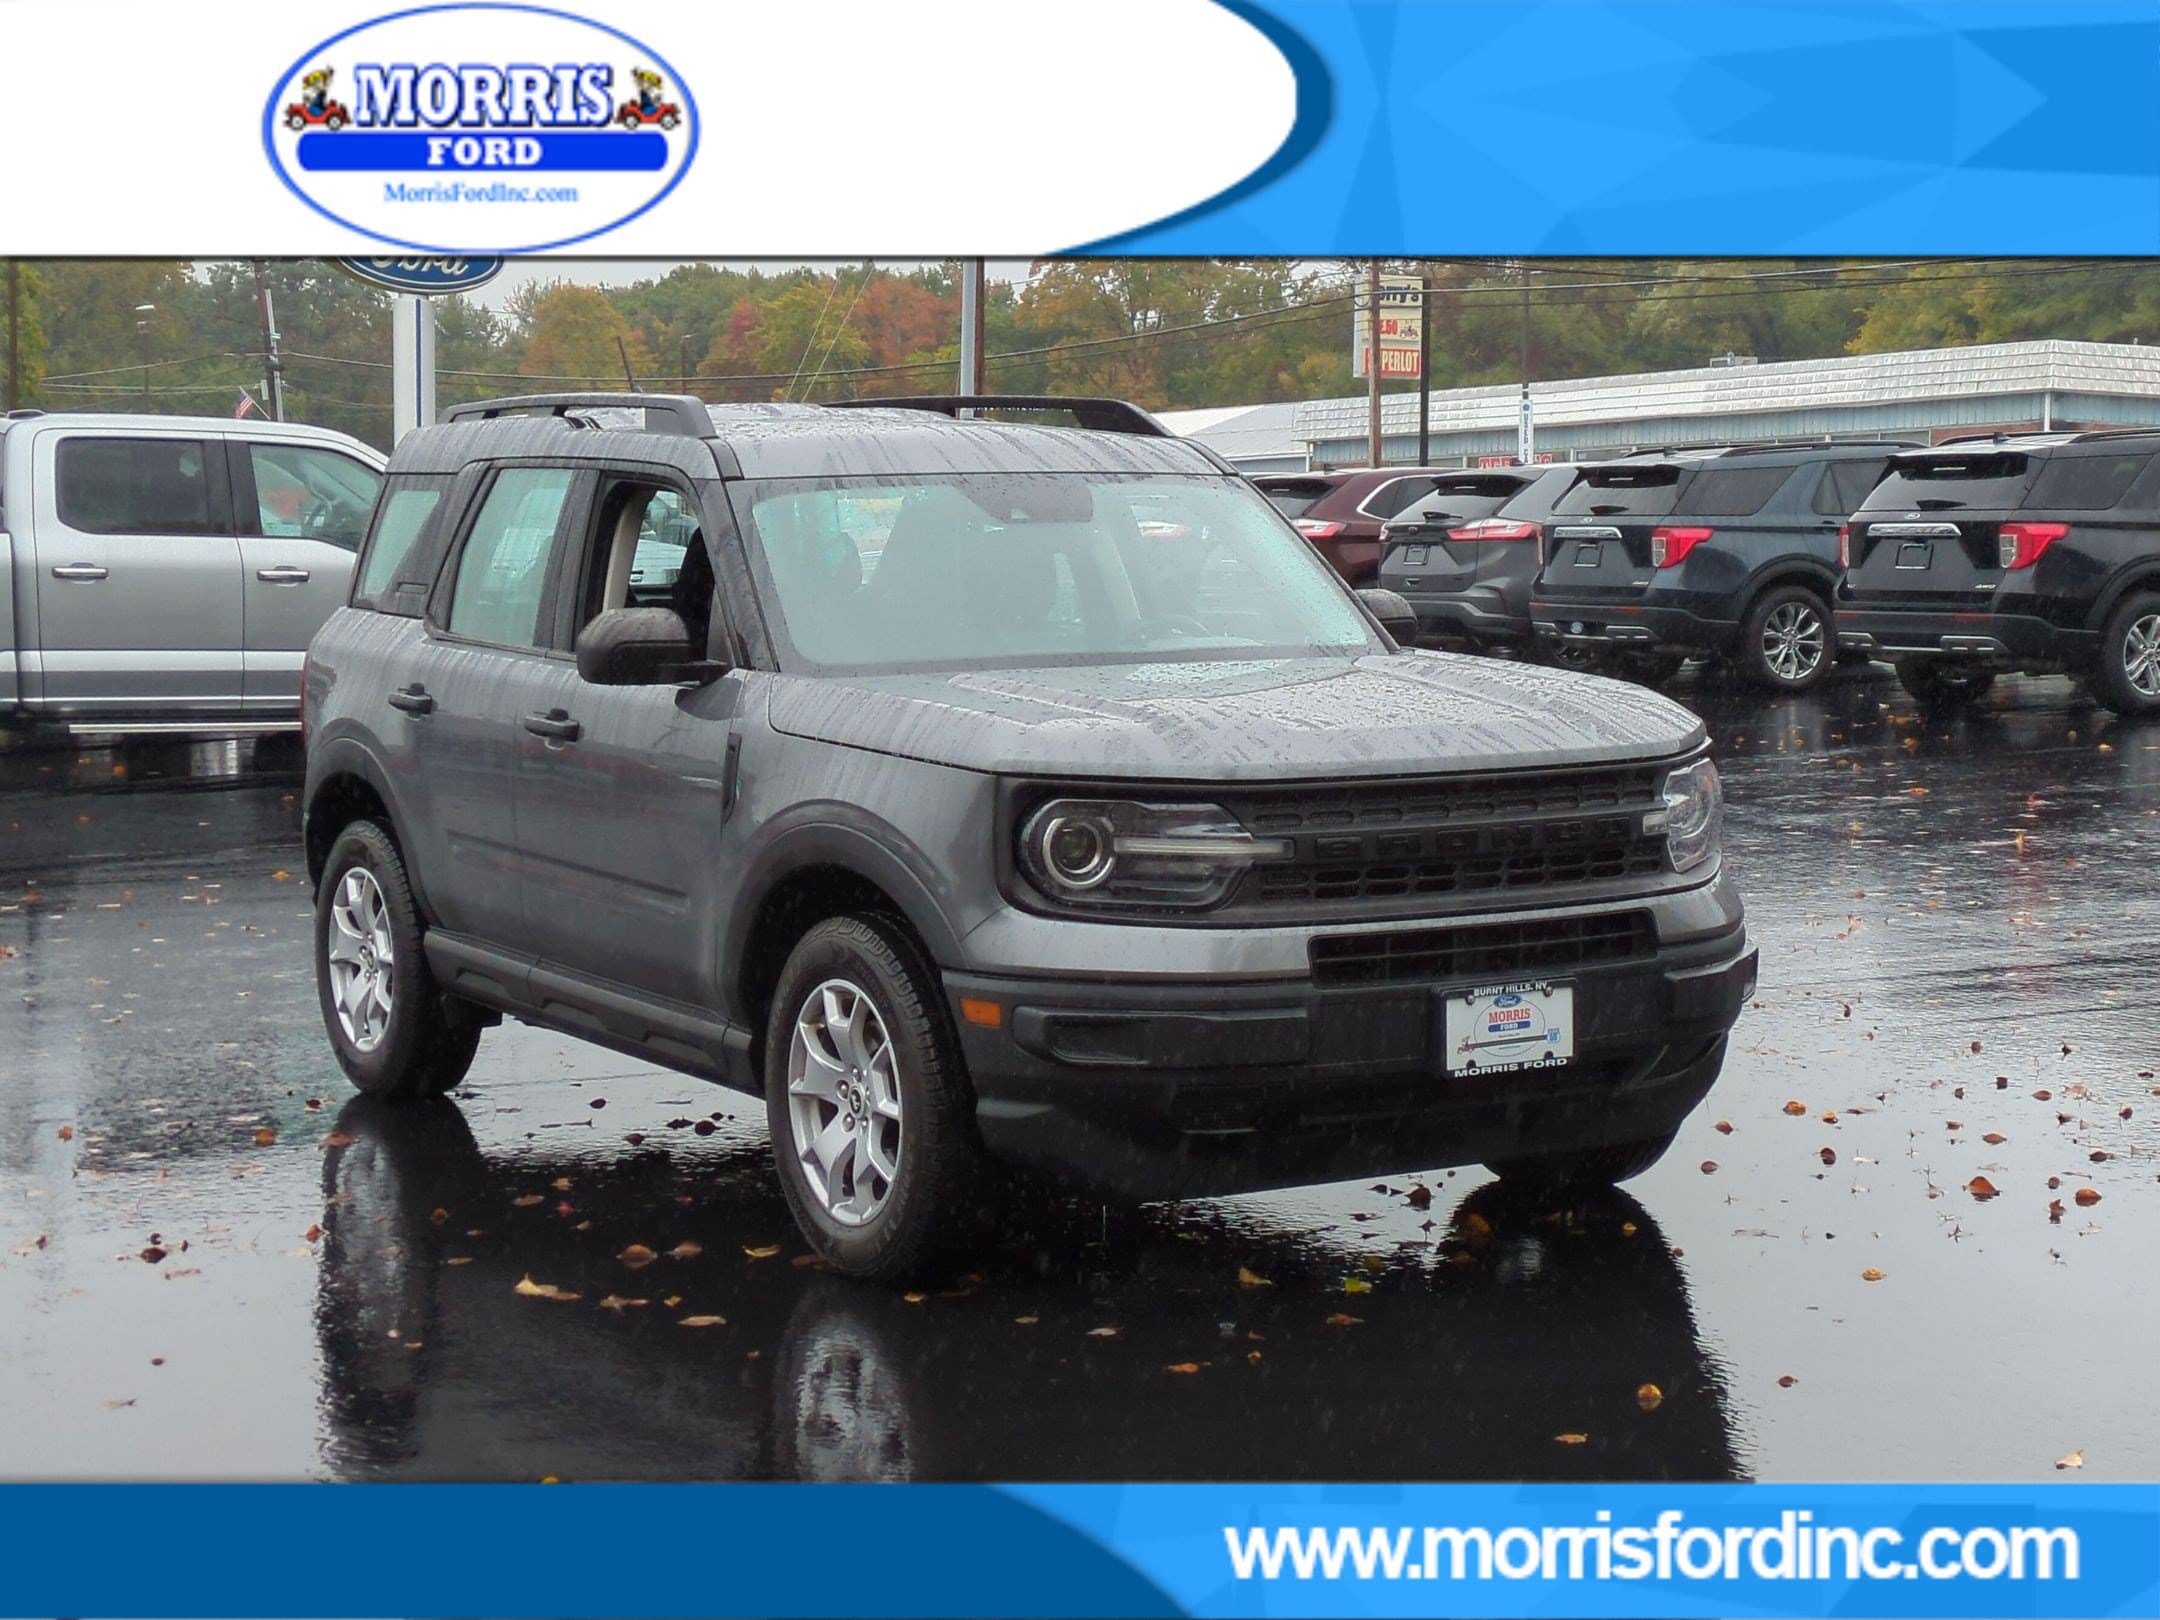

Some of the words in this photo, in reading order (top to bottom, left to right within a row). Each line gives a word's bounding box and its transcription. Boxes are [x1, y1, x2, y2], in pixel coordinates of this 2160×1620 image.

[1473, 986, 1503, 997] BURNT
[1535, 981, 1548, 991] NY
[1488, 1008, 1531, 1024] MORRIS
[1454, 1063, 1519, 1078] MORRIS
[1524, 1058, 1568, 1070] FORD
